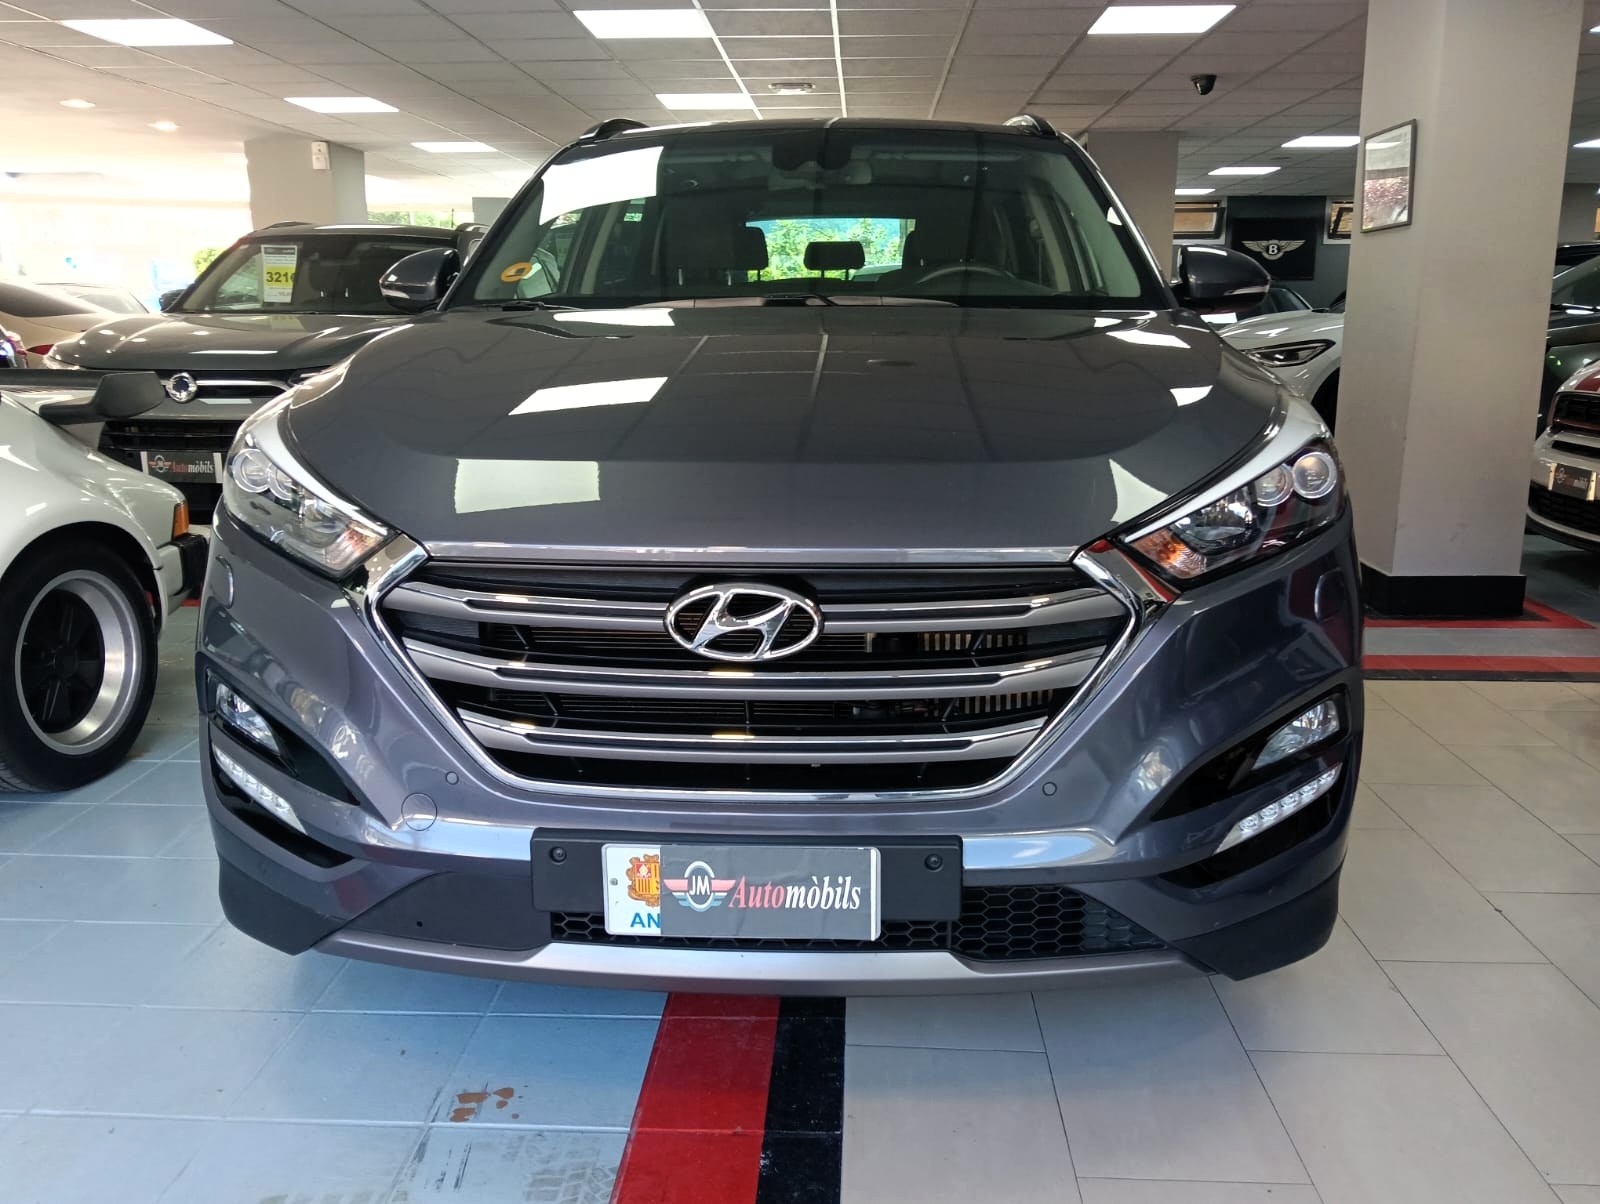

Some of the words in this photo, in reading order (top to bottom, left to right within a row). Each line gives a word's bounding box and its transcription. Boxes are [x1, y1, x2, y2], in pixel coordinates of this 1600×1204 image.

[1268, 244, 1278, 255] B
[689, 875, 711, 896] JM
[728, 875, 862, 910] Automòbils
